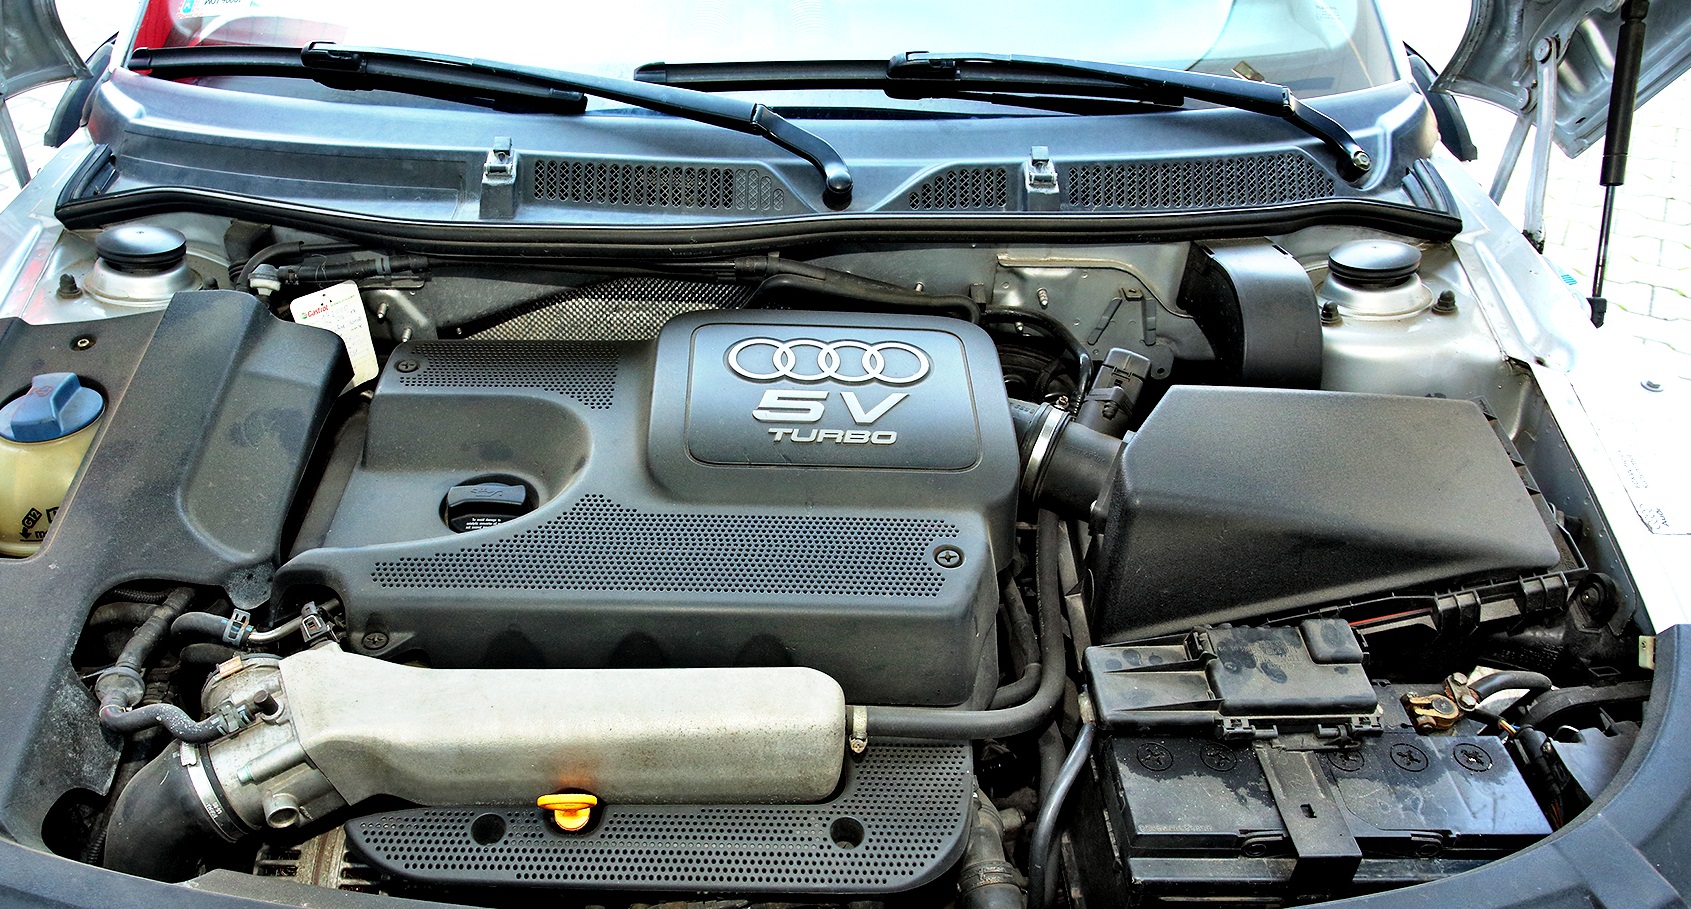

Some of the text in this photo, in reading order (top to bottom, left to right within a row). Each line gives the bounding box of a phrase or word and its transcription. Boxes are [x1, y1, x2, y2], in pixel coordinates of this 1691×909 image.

[307, 304, 329, 318] Castrol
[768, 427, 898, 446] TURBO
[23, 509, 42, 528] G12
